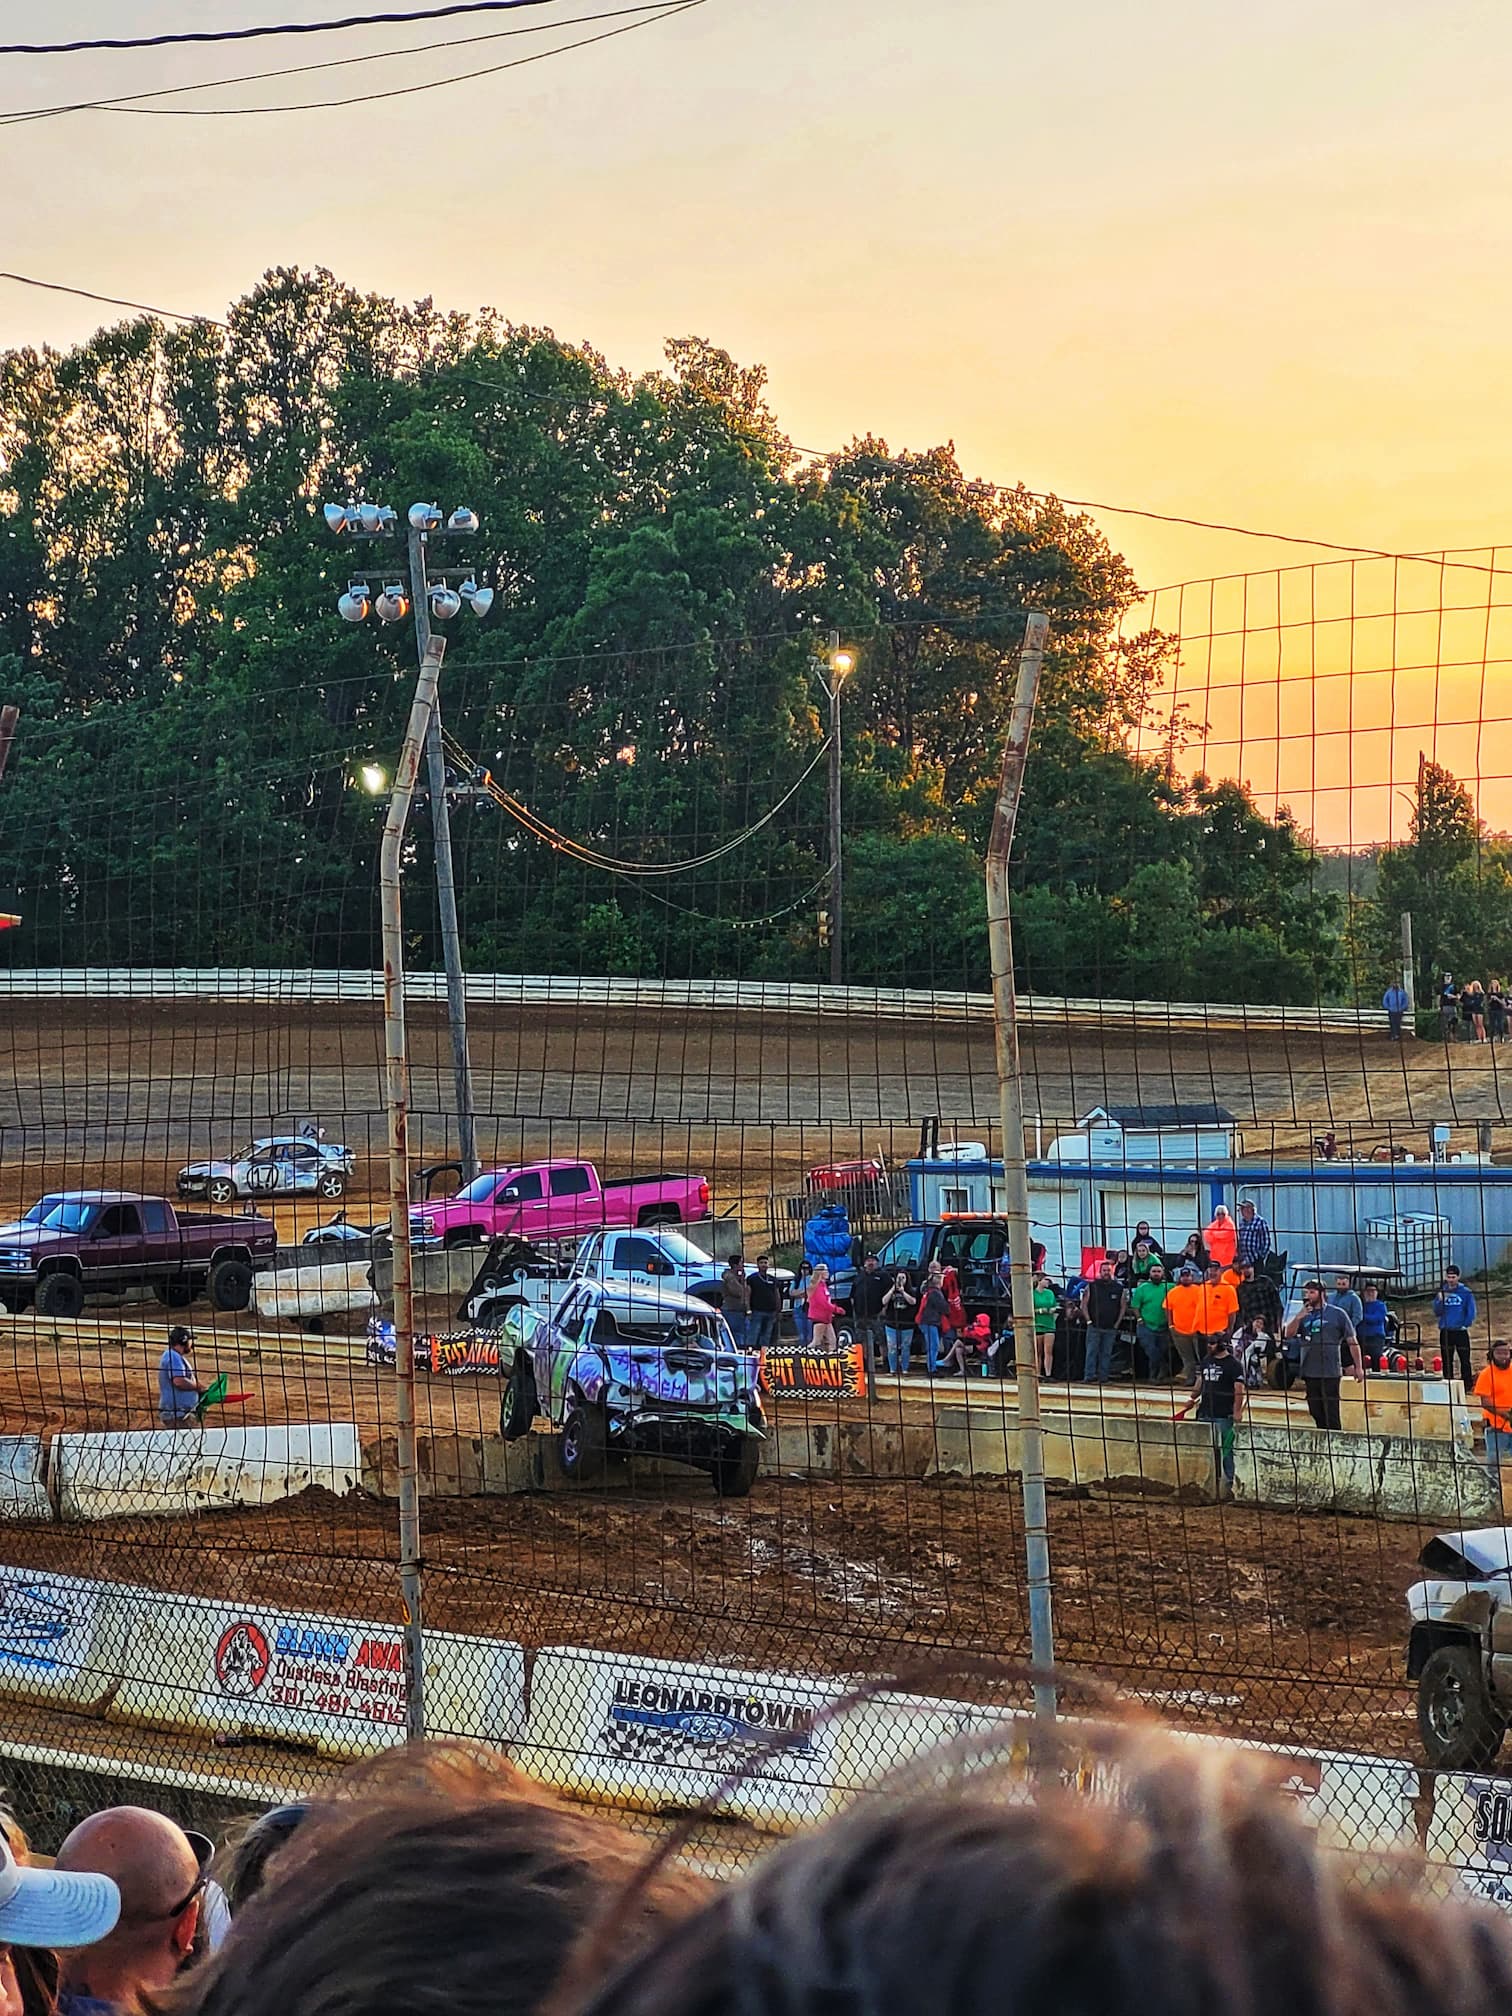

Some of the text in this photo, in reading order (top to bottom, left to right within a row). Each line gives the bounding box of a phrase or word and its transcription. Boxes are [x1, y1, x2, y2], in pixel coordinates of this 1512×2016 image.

[252, 1167, 274, 1189] 17
[770, 1357, 843, 1387] PIT ROAD
[355, 1639, 403, 1673] AWA
[276, 1658, 341, 1687] Dustless
[614, 1678, 813, 1735] LEONARDTOWN
[690, 1716, 727, 1739] Ford
[1474, 1790, 1512, 1847] SO
